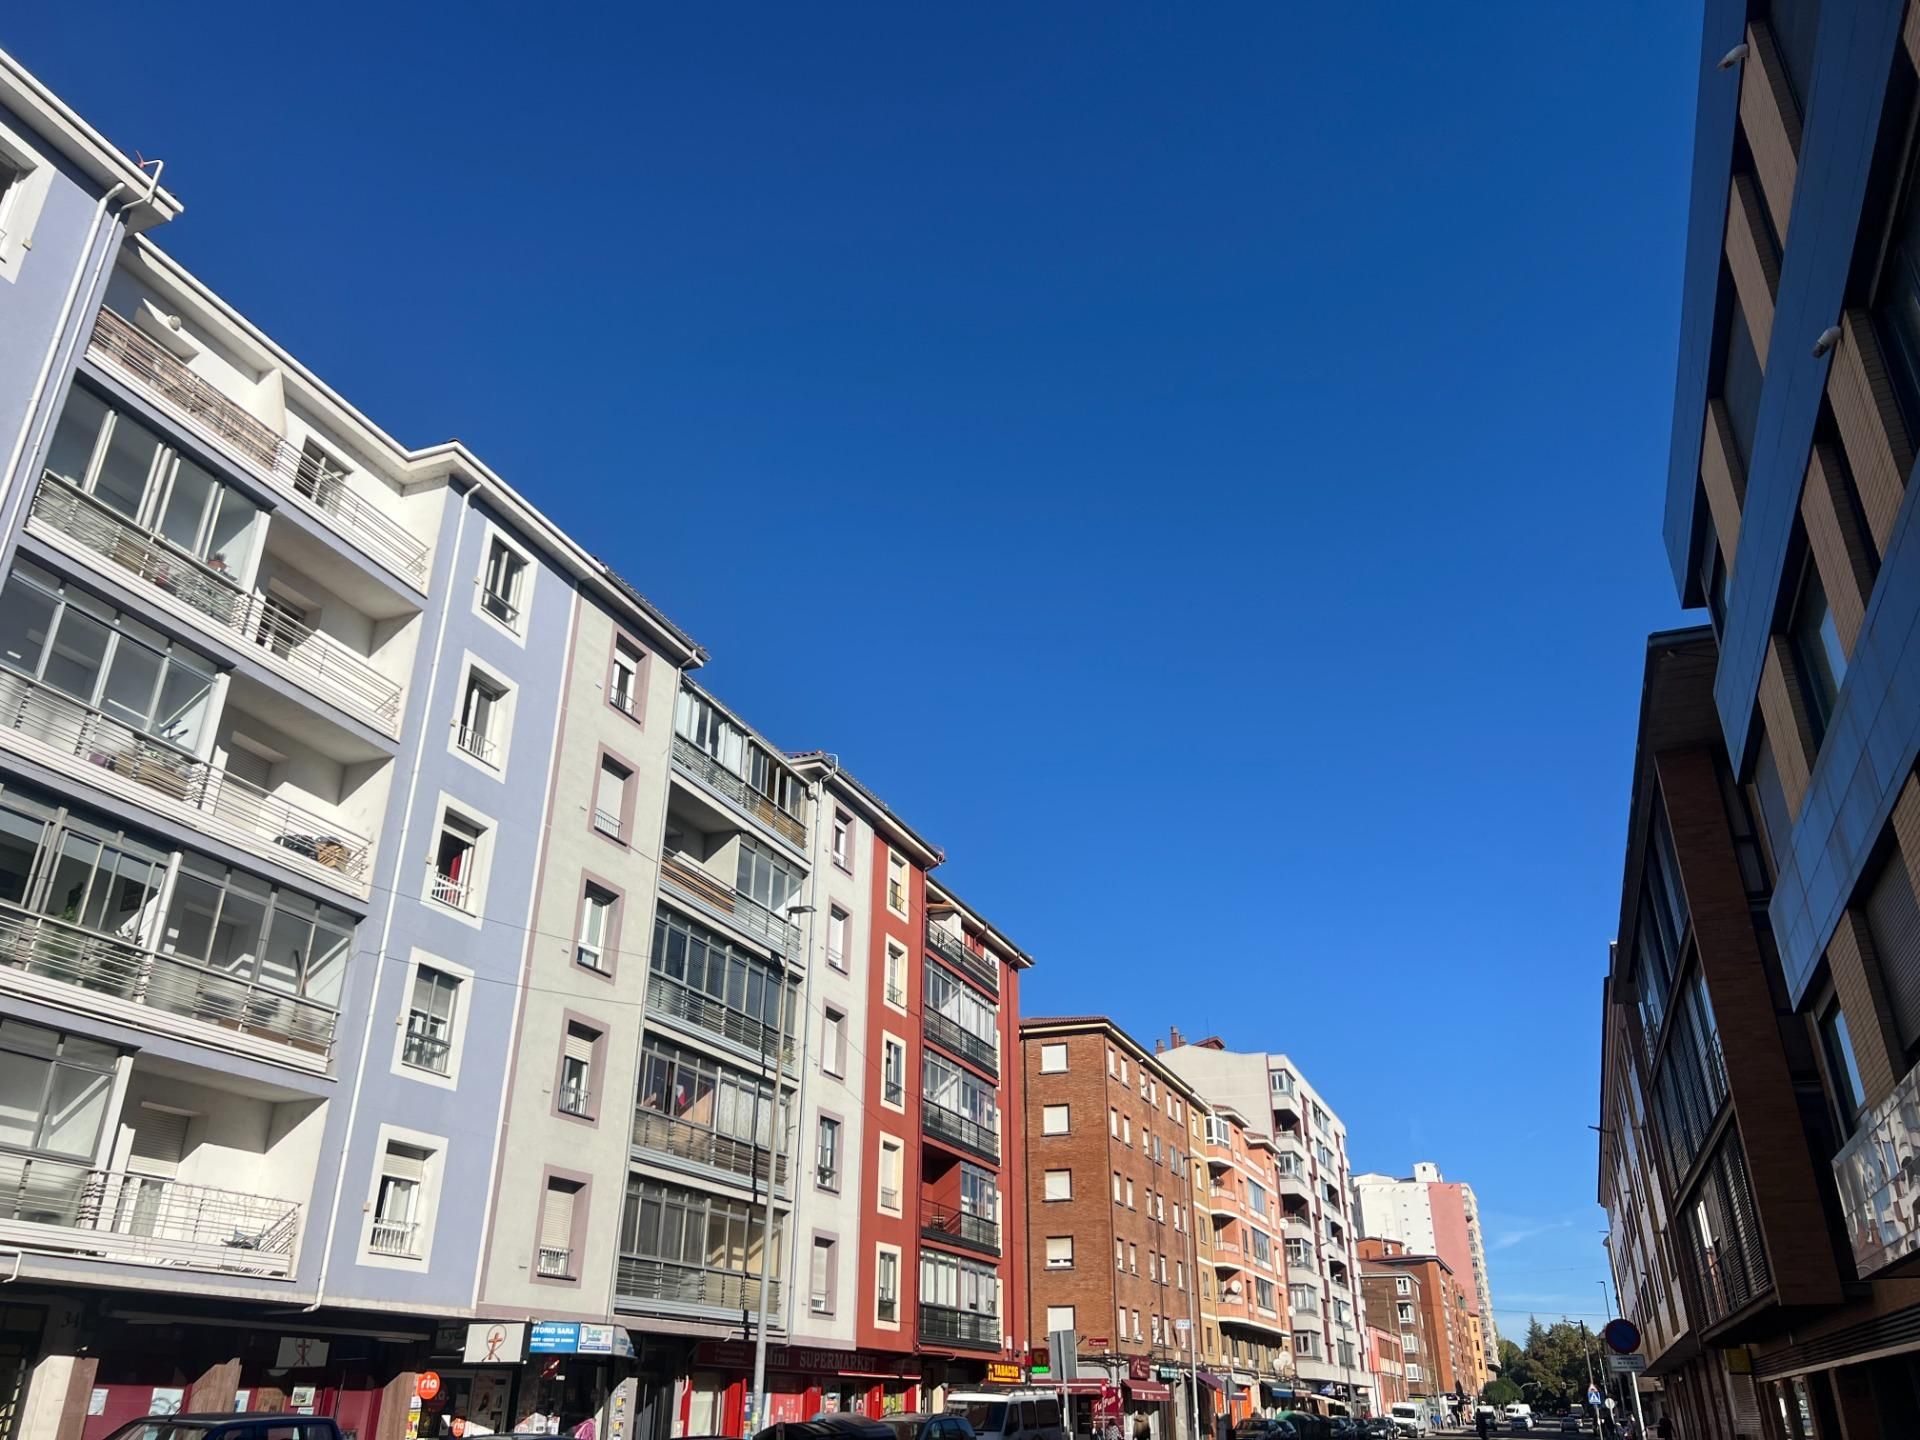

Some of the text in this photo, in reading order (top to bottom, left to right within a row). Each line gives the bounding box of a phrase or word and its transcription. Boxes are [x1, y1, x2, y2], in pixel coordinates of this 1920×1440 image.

[557, 1327, 574, 1335] SARA
[800, 1350, 877, 1372] SUPERMARKET
[994, 1363, 1019, 1378] TABACOS
